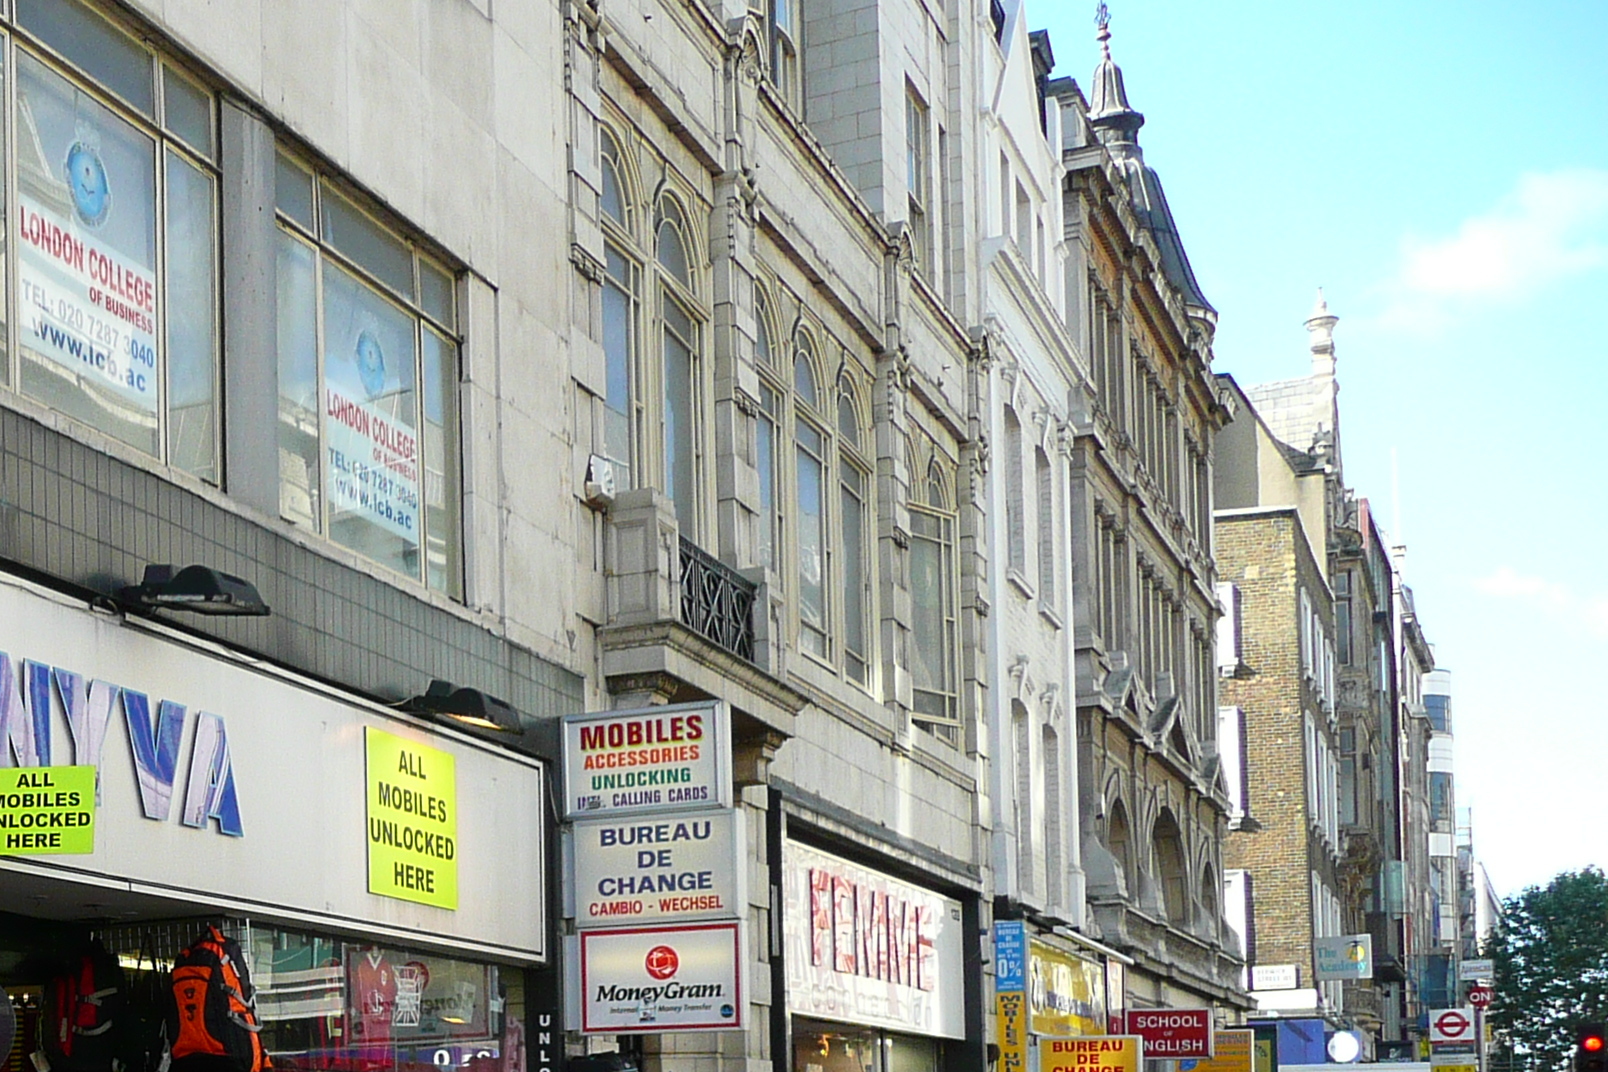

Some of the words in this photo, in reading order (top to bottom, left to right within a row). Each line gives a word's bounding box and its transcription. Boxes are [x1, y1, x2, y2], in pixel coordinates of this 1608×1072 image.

[20, 206, 84, 272] LONDON
[89, 248, 152, 313] COLLEGE
[89, 286, 102, 304] OF
[105, 297, 153, 335] BUSINESS
[22, 278, 54, 312] TEL:
[58, 299, 83, 327] 020
[88, 315, 119, 348] 7287
[124, 334, 154, 368] 3040
[32, 316, 146, 392] www.lcb.ac
[327, 389, 370, 438] LONDON
[372, 416, 415, 463] COLLEGE
[580, 715, 702, 751] MOBILES
[399, 750, 426, 779] ALL
[584, 745, 699, 770] ACCESSORIES
[16, 773, 54, 788] ALL
[592, 768, 691, 790] UNLOCKING
[379, 781, 446, 823] MOBILES
[613, 790, 661, 806] CALLING
[668, 786, 707, 802] CARDS
[6, 832, 62, 848] HERE
[370, 817, 454, 860] UNLOCKED
[600, 820, 711, 847] BUREAU
[638, 850, 672, 869] DE
[394, 862, 434, 893] HERE
[598, 871, 712, 897] CHANGE
[589, 901, 642, 916] CAMBIO
[659, 896, 723, 911] WECHSEL
[998, 959, 1021, 978] 0%
[1319, 961, 1366, 973] Academy
[596, 982, 721, 1002] MoneyGram
[1470, 992, 1491, 1002] ON
[1137, 1016, 1203, 1028] SCHOOL
[1053, 1040, 1123, 1052] BUREAU
[1144, 1040, 1203, 1051] NGLISH
[1077, 1054, 1100, 1064] DE
